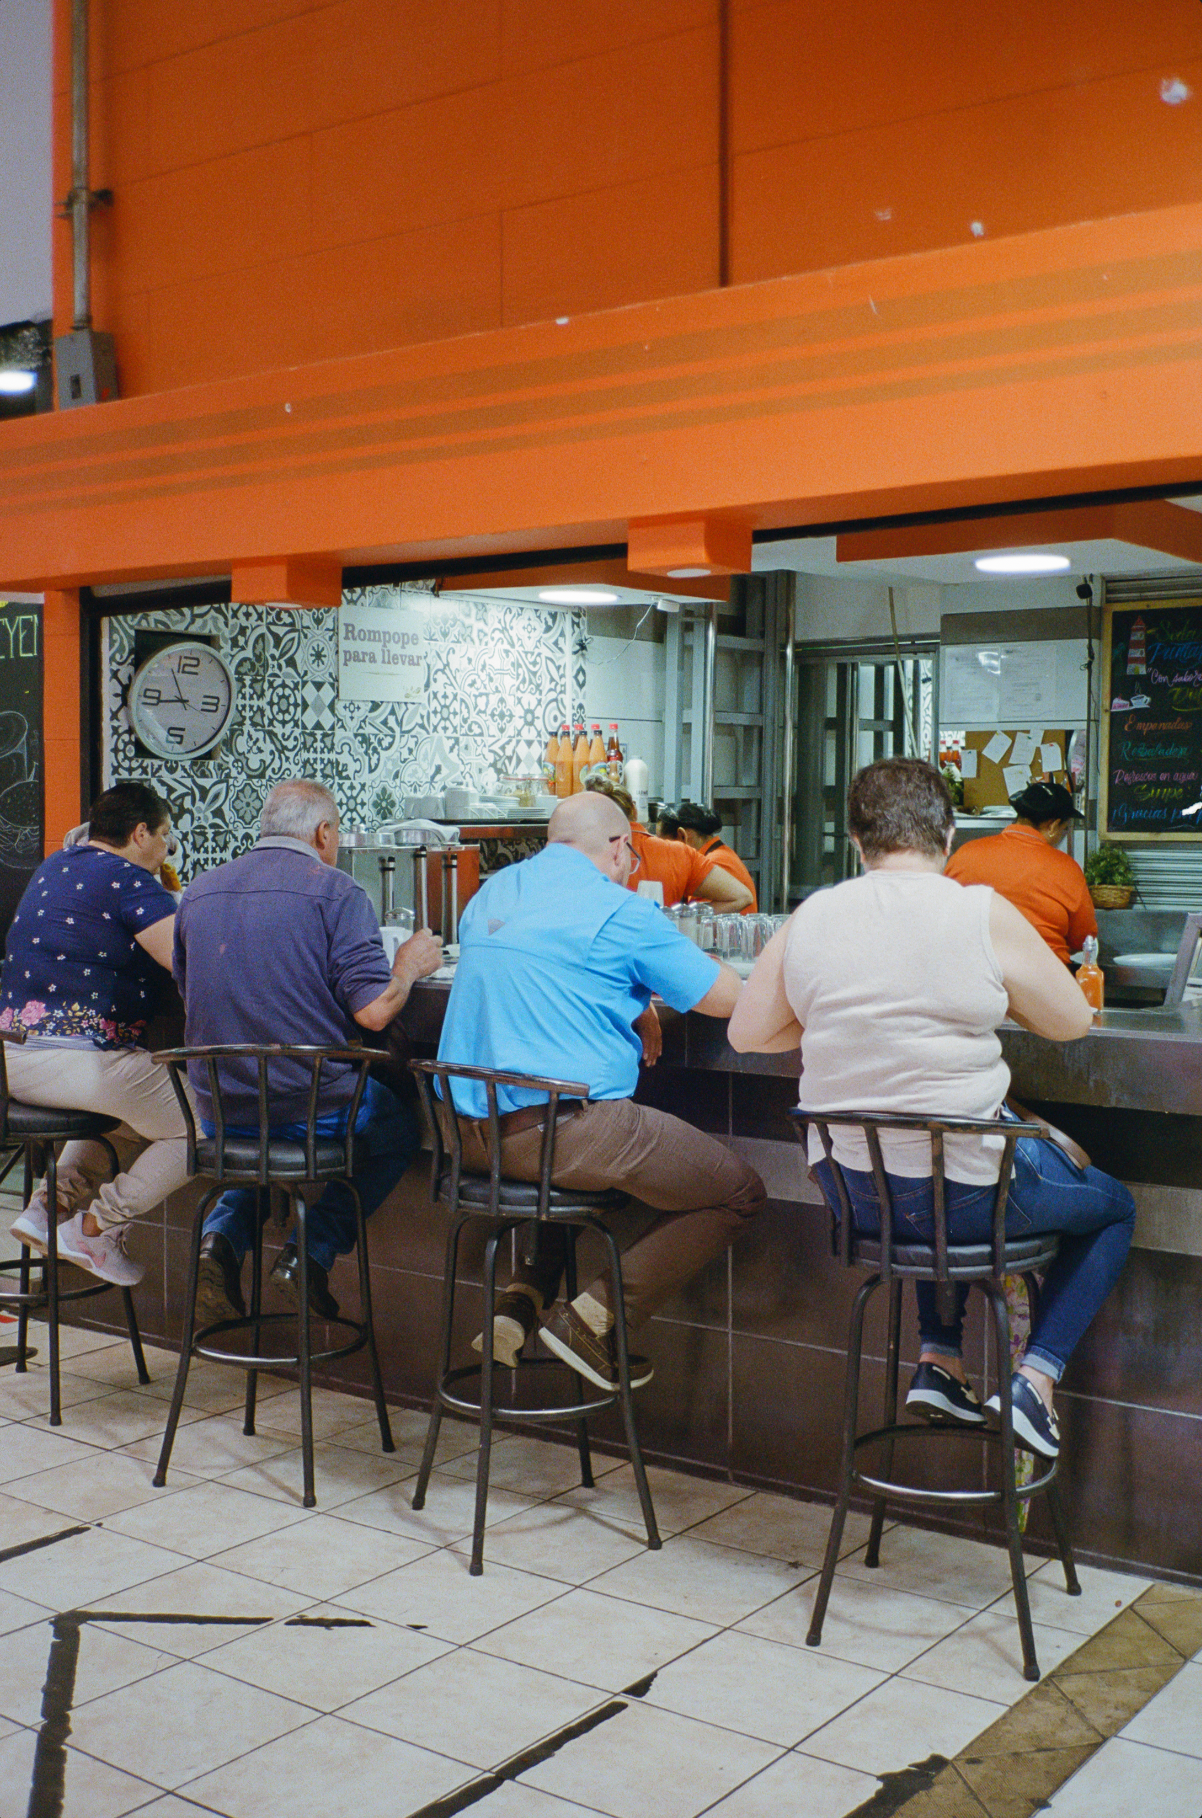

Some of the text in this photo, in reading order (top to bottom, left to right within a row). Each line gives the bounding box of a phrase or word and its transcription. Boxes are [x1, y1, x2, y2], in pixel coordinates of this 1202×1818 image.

[343, 622, 419, 649] Rompope
[177, 655, 200, 675] 12
[343, 648, 422, 667] para llevar
[141, 688, 161, 706] 9
[200, 694, 220, 713] 3
